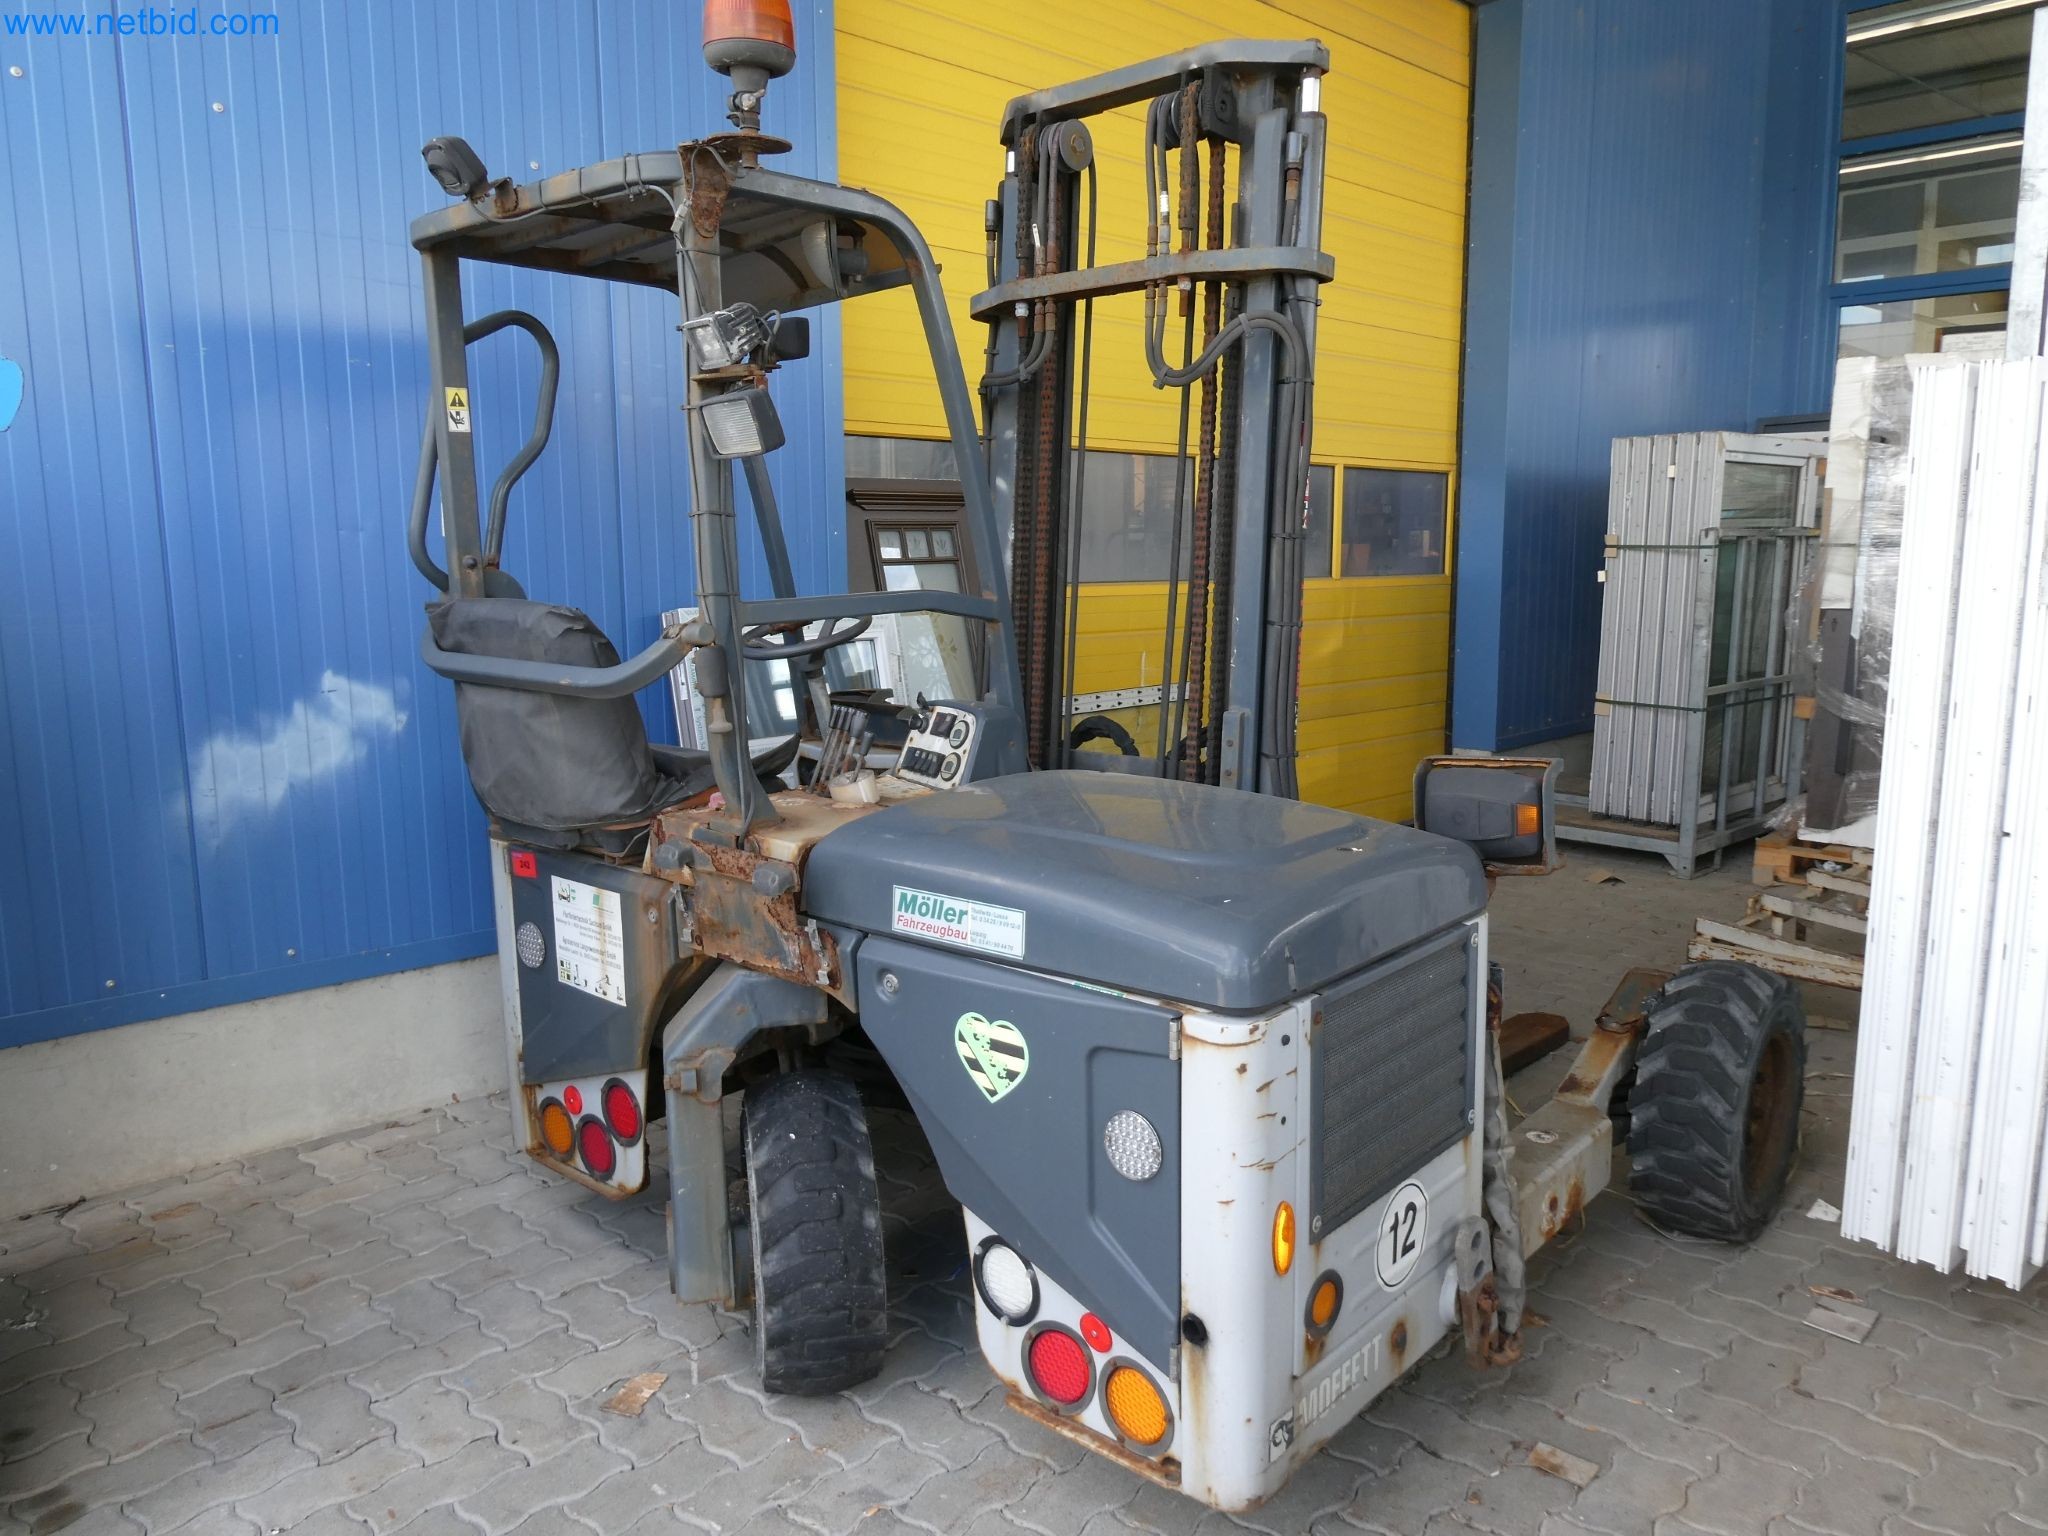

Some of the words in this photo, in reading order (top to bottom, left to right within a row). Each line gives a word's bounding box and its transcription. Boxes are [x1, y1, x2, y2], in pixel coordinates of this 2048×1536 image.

[896, 915, 968, 941] Fahrzeugbau
[897, 892, 968, 925] Möller
[1389, 1201, 1418, 1265] 12
[1298, 1333, 1382, 1425] MOFFETT
